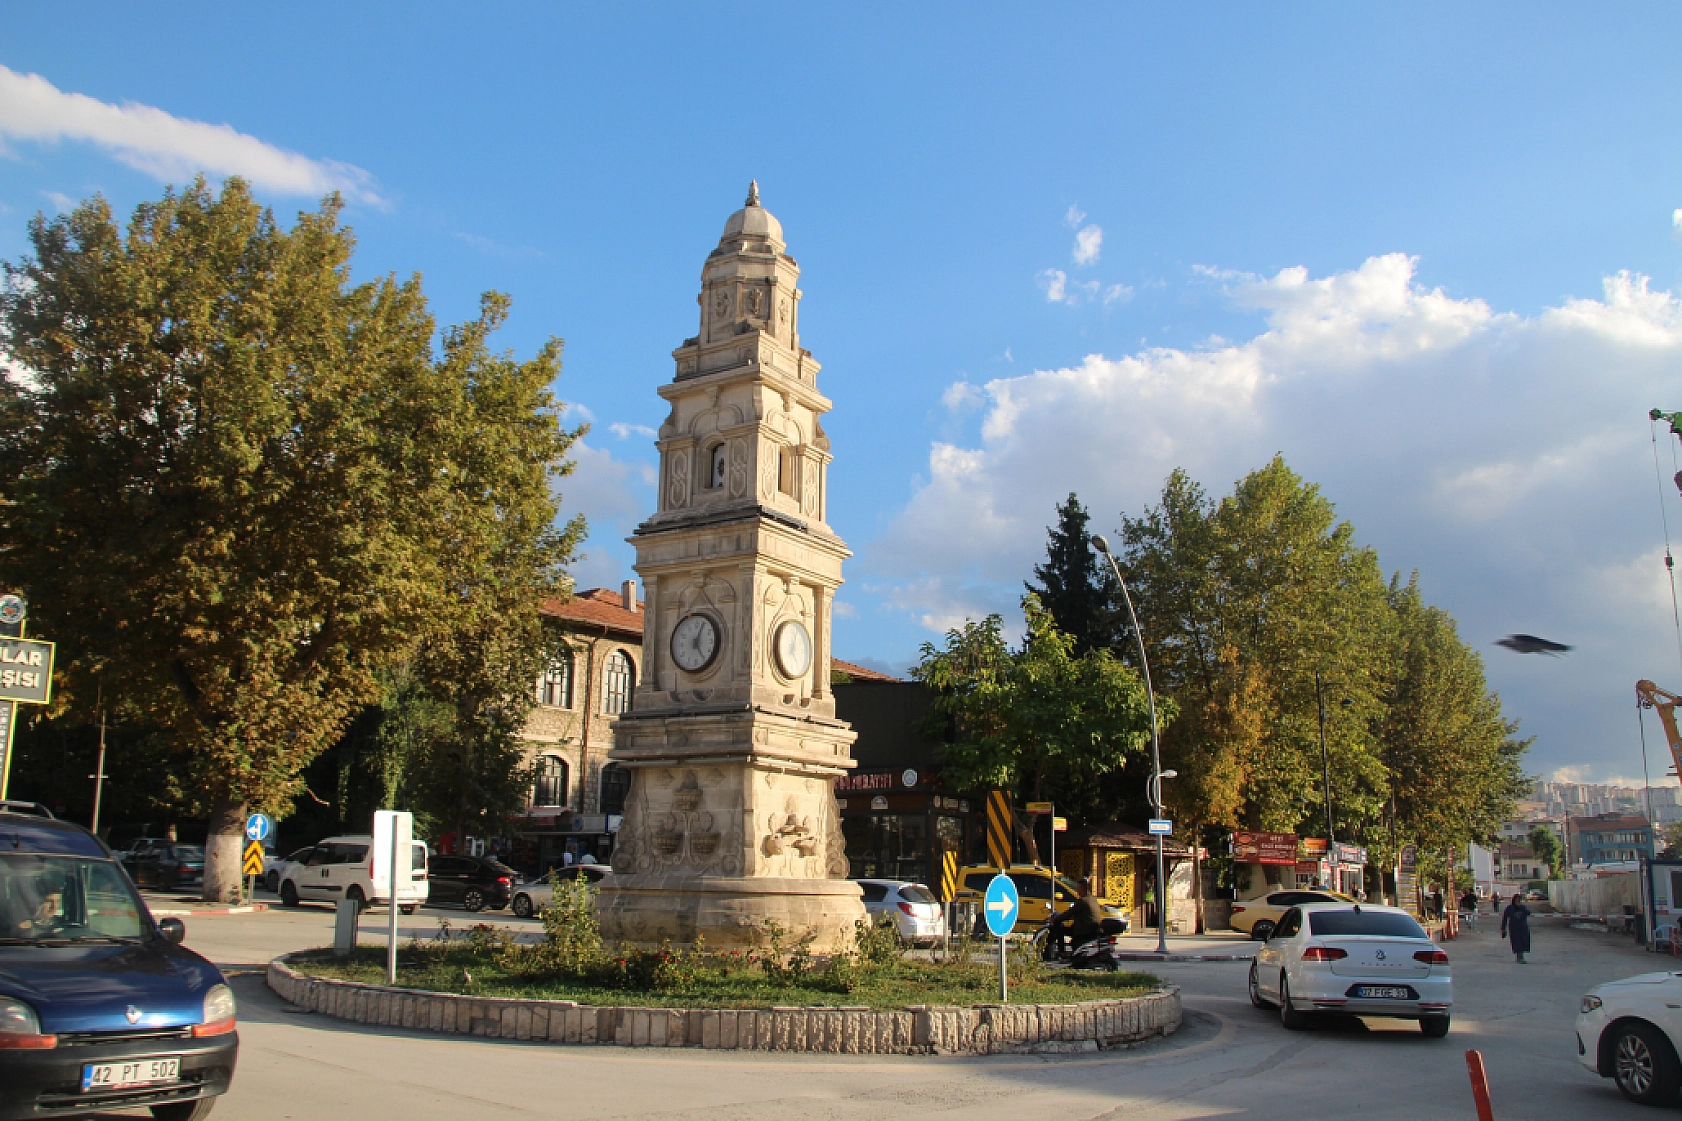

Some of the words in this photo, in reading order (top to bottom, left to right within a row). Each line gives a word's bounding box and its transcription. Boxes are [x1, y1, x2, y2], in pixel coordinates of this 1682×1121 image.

[92, 1066, 112, 1083] 42
[122, 1063, 141, 1081] PT
[151, 1060, 177, 1078] 502
